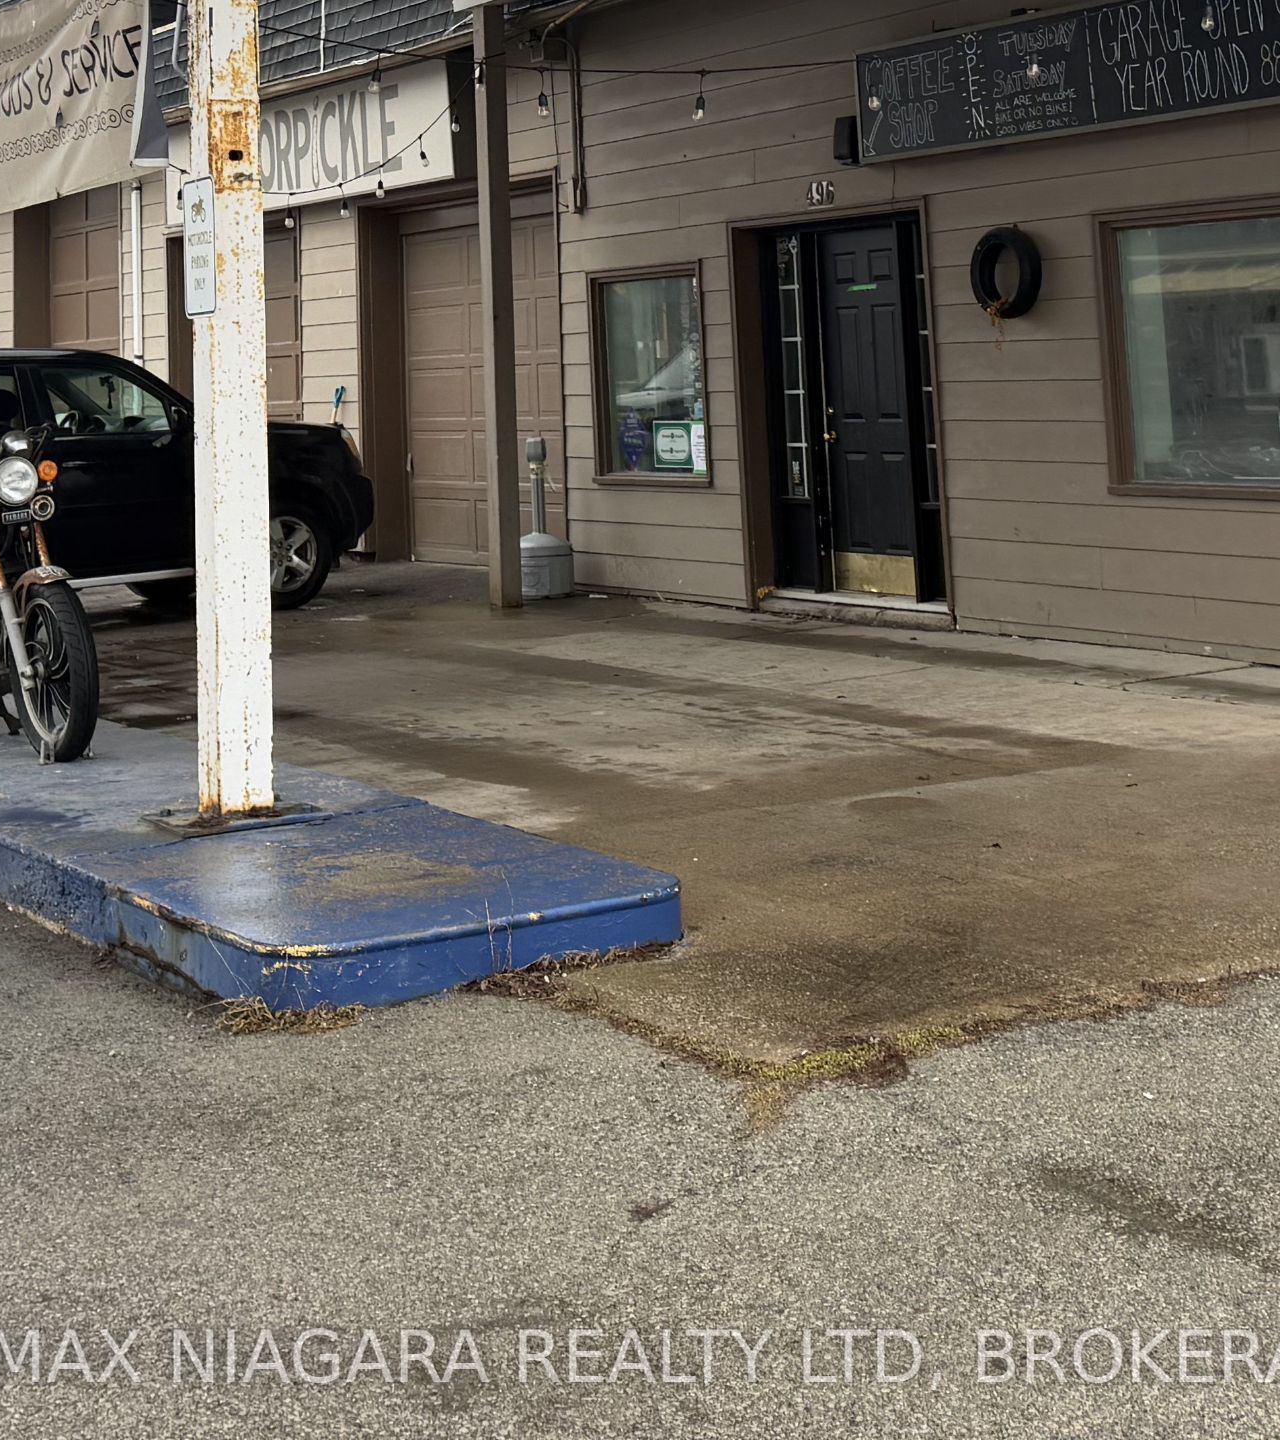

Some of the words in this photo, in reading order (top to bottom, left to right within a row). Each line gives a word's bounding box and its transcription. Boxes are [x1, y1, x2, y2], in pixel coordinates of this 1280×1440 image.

[997, 19, 1077, 57] TUESDAY
[35, 56, 54, 106] &
[61, 24, 143, 98] SERVICE
[865, 46, 956, 101] COFFEE
[963, 34, 986, 131] OPEN
[1114, 56, 1173, 113] YEAR
[1180, 43, 1250, 103] ROUND
[887, 99, 939, 149] SHOP
[994, 101, 1011, 112] ALL
[1013, 94, 1033, 106] ARE
[1034, 87, 1077, 102] WELCOME
[1013, 108, 1027, 119] OR
[1028, 106, 1043, 117] NO
[1045, 100, 1073, 115] BIKE!
[995, 124, 1018, 137] GOOD
[1018, 119, 1044, 132] VIBES
[1046, 116, 1070, 128] ONLY
